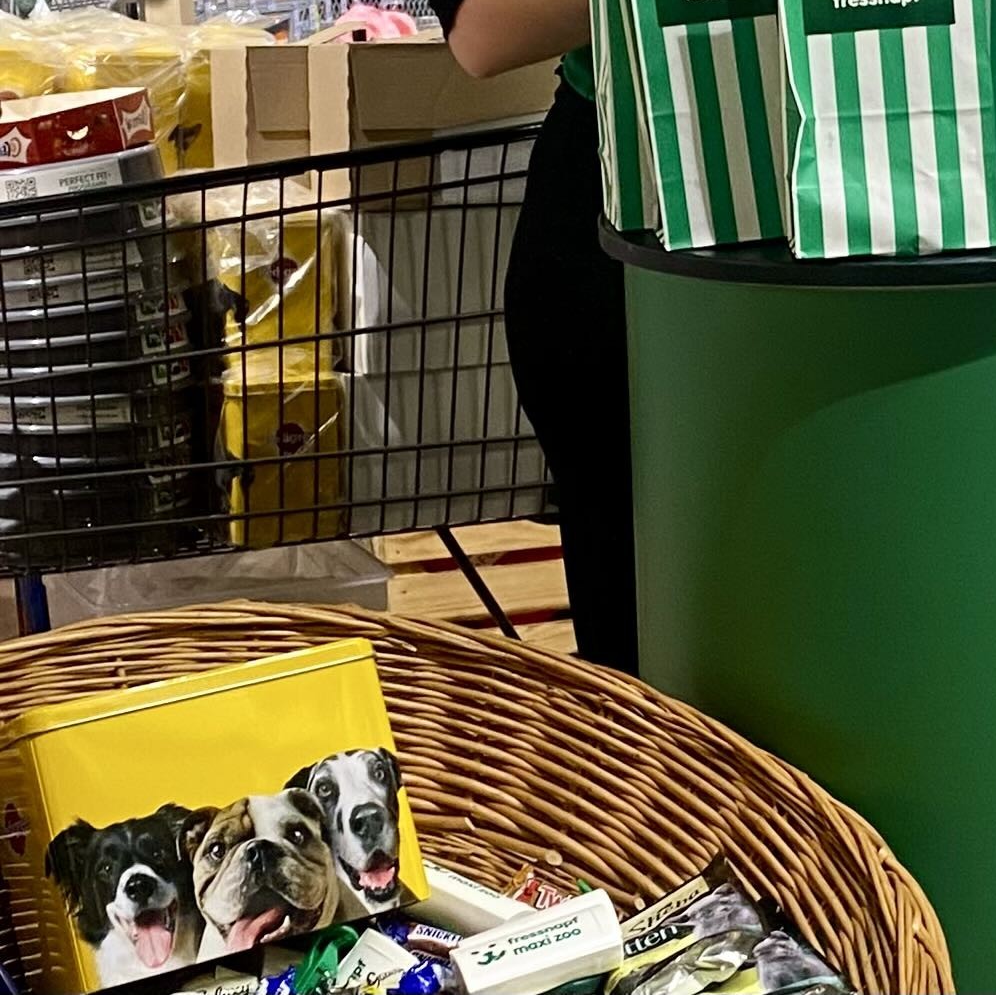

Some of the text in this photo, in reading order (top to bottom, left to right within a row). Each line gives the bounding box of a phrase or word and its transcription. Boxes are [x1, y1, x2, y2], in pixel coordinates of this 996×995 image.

[507, 916, 578, 944] fressnapf
[513, 928, 582, 955] maxi zoo
